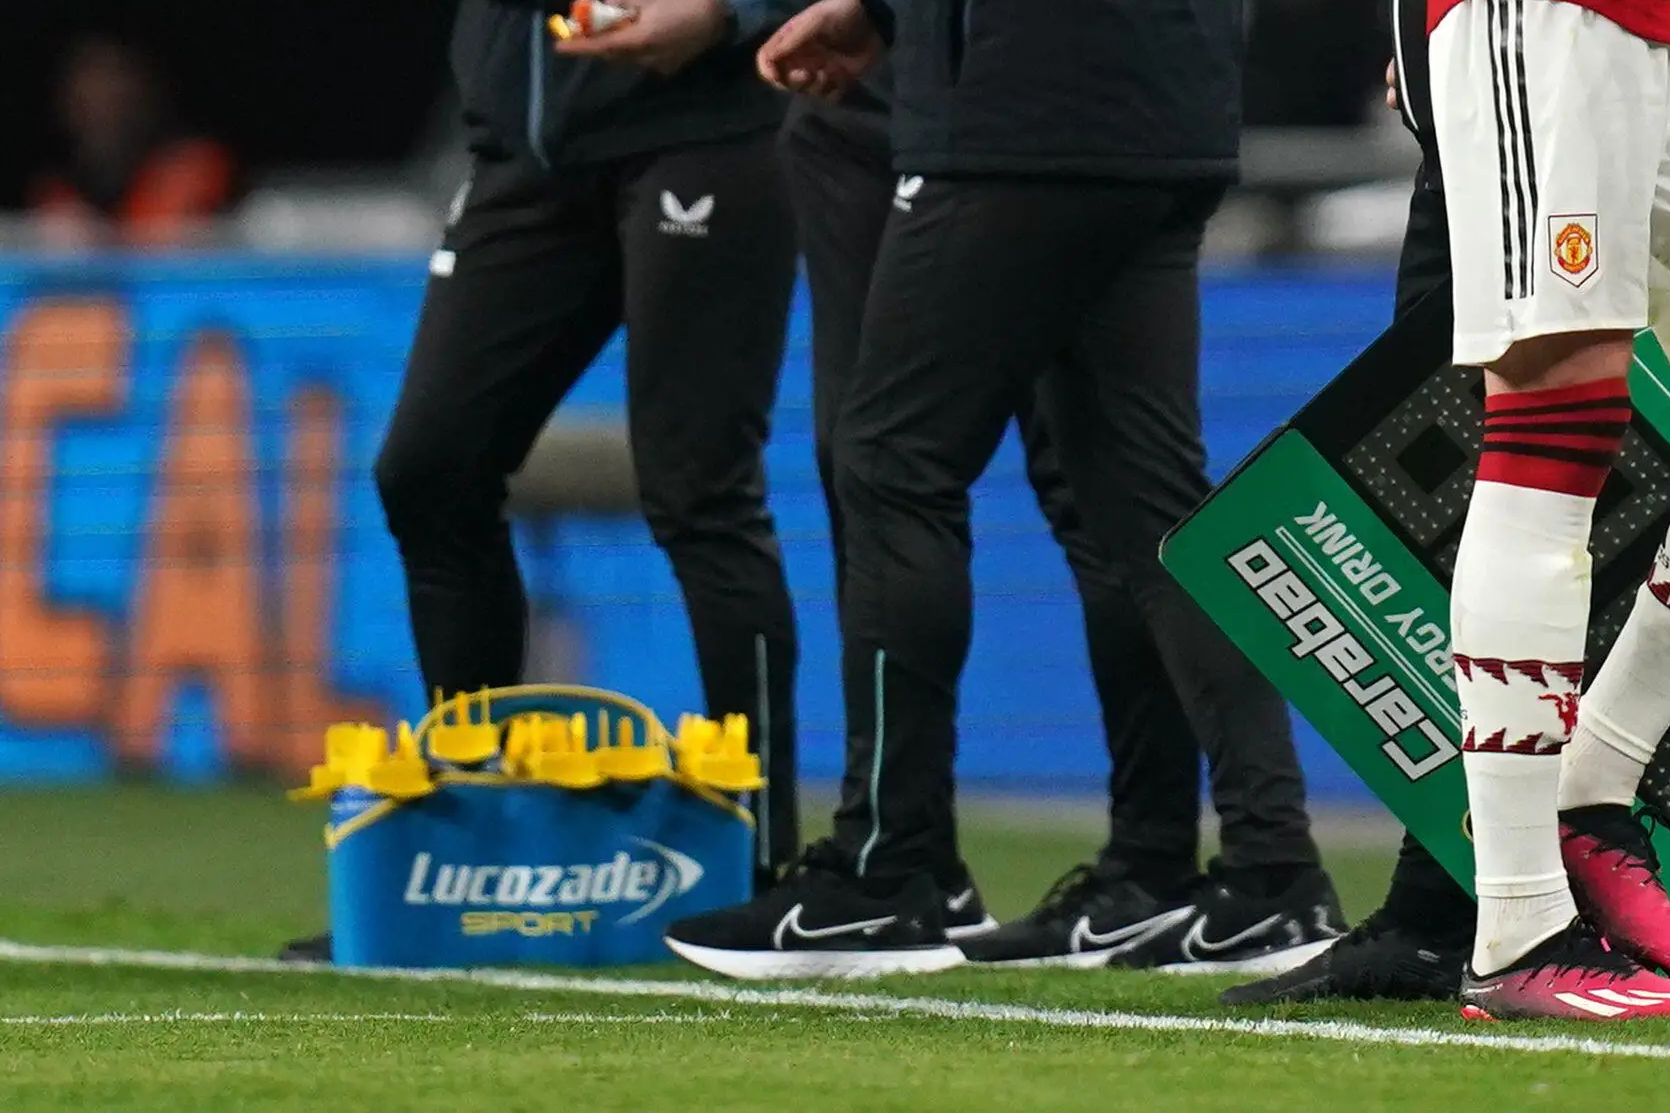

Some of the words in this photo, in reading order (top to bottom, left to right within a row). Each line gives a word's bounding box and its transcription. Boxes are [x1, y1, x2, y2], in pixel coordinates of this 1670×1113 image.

[1294, 501, 1402, 606] DRINK
[1224, 536, 1463, 783] Carabao
[1384, 607, 1458, 693] RGY
[403, 851, 658, 906] Lucozade
[459, 910, 600, 937] SPORT
